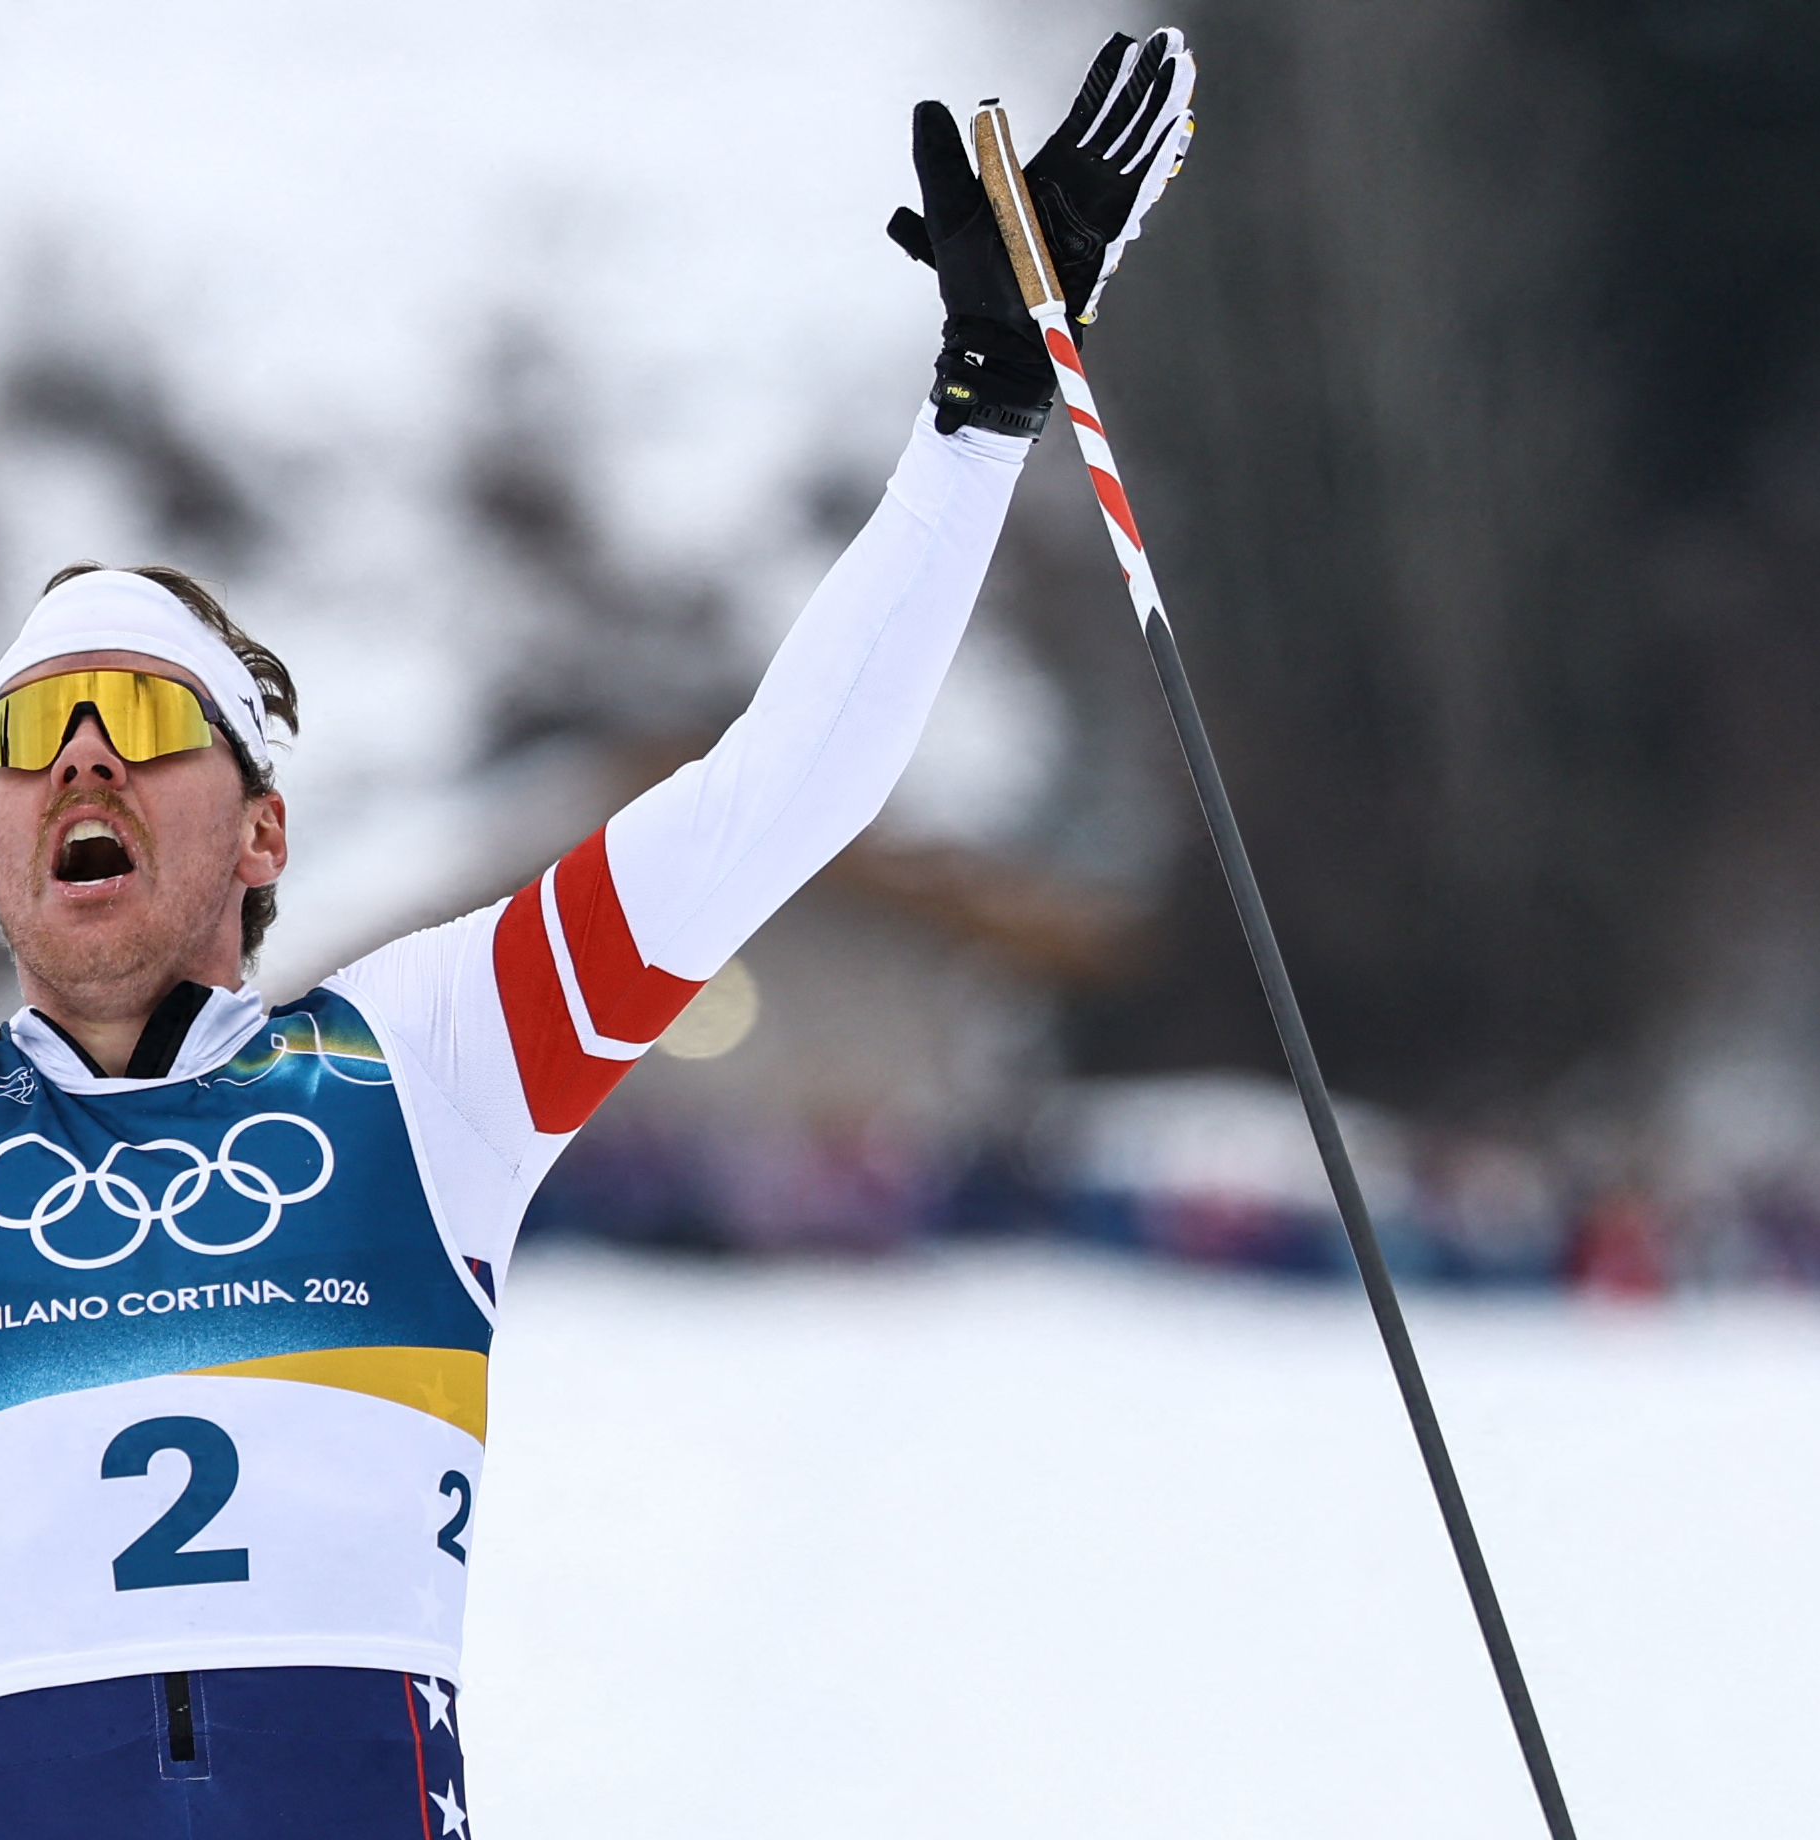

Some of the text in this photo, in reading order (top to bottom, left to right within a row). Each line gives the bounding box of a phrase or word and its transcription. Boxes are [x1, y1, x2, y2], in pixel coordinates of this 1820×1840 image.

[117, 1280, 295, 1317] CORTINA
[304, 1278, 370, 1307] 2026
[101, 1416, 249, 1591] 2
[437, 1470, 471, 1566] 2
